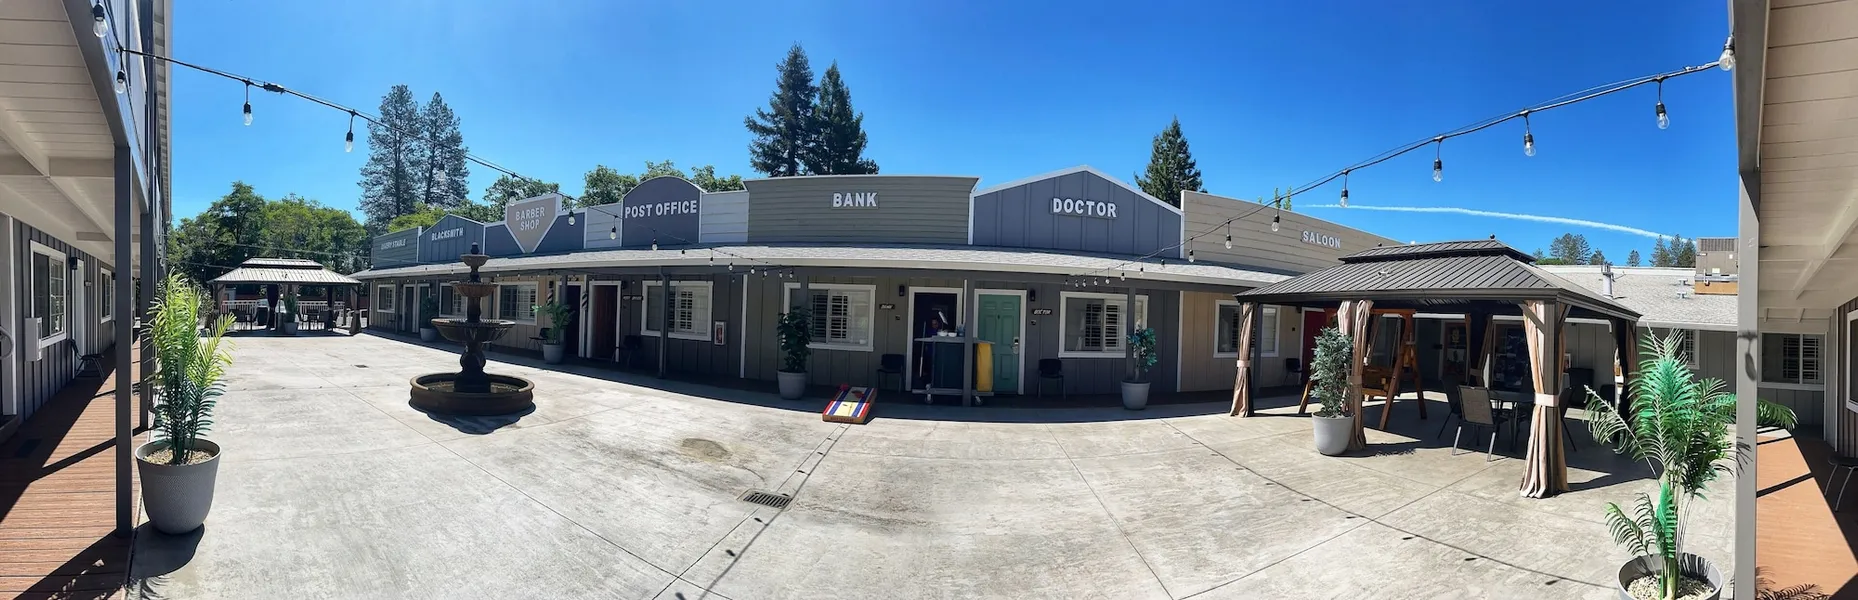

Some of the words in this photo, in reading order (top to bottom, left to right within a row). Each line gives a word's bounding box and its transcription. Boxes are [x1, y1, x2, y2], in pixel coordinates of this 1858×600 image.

[833, 192, 877, 207] BANK
[515, 207, 545, 221] BARBER
[625, 204, 653, 219] POST
[655, 200, 697, 216] OFFICE
[1053, 198, 1117, 218] DOCTOR
[520, 219, 540, 231] SHOP
[431, 228, 464, 241] BLACKSMITH
[1303, 230, 1341, 248] SALOON
